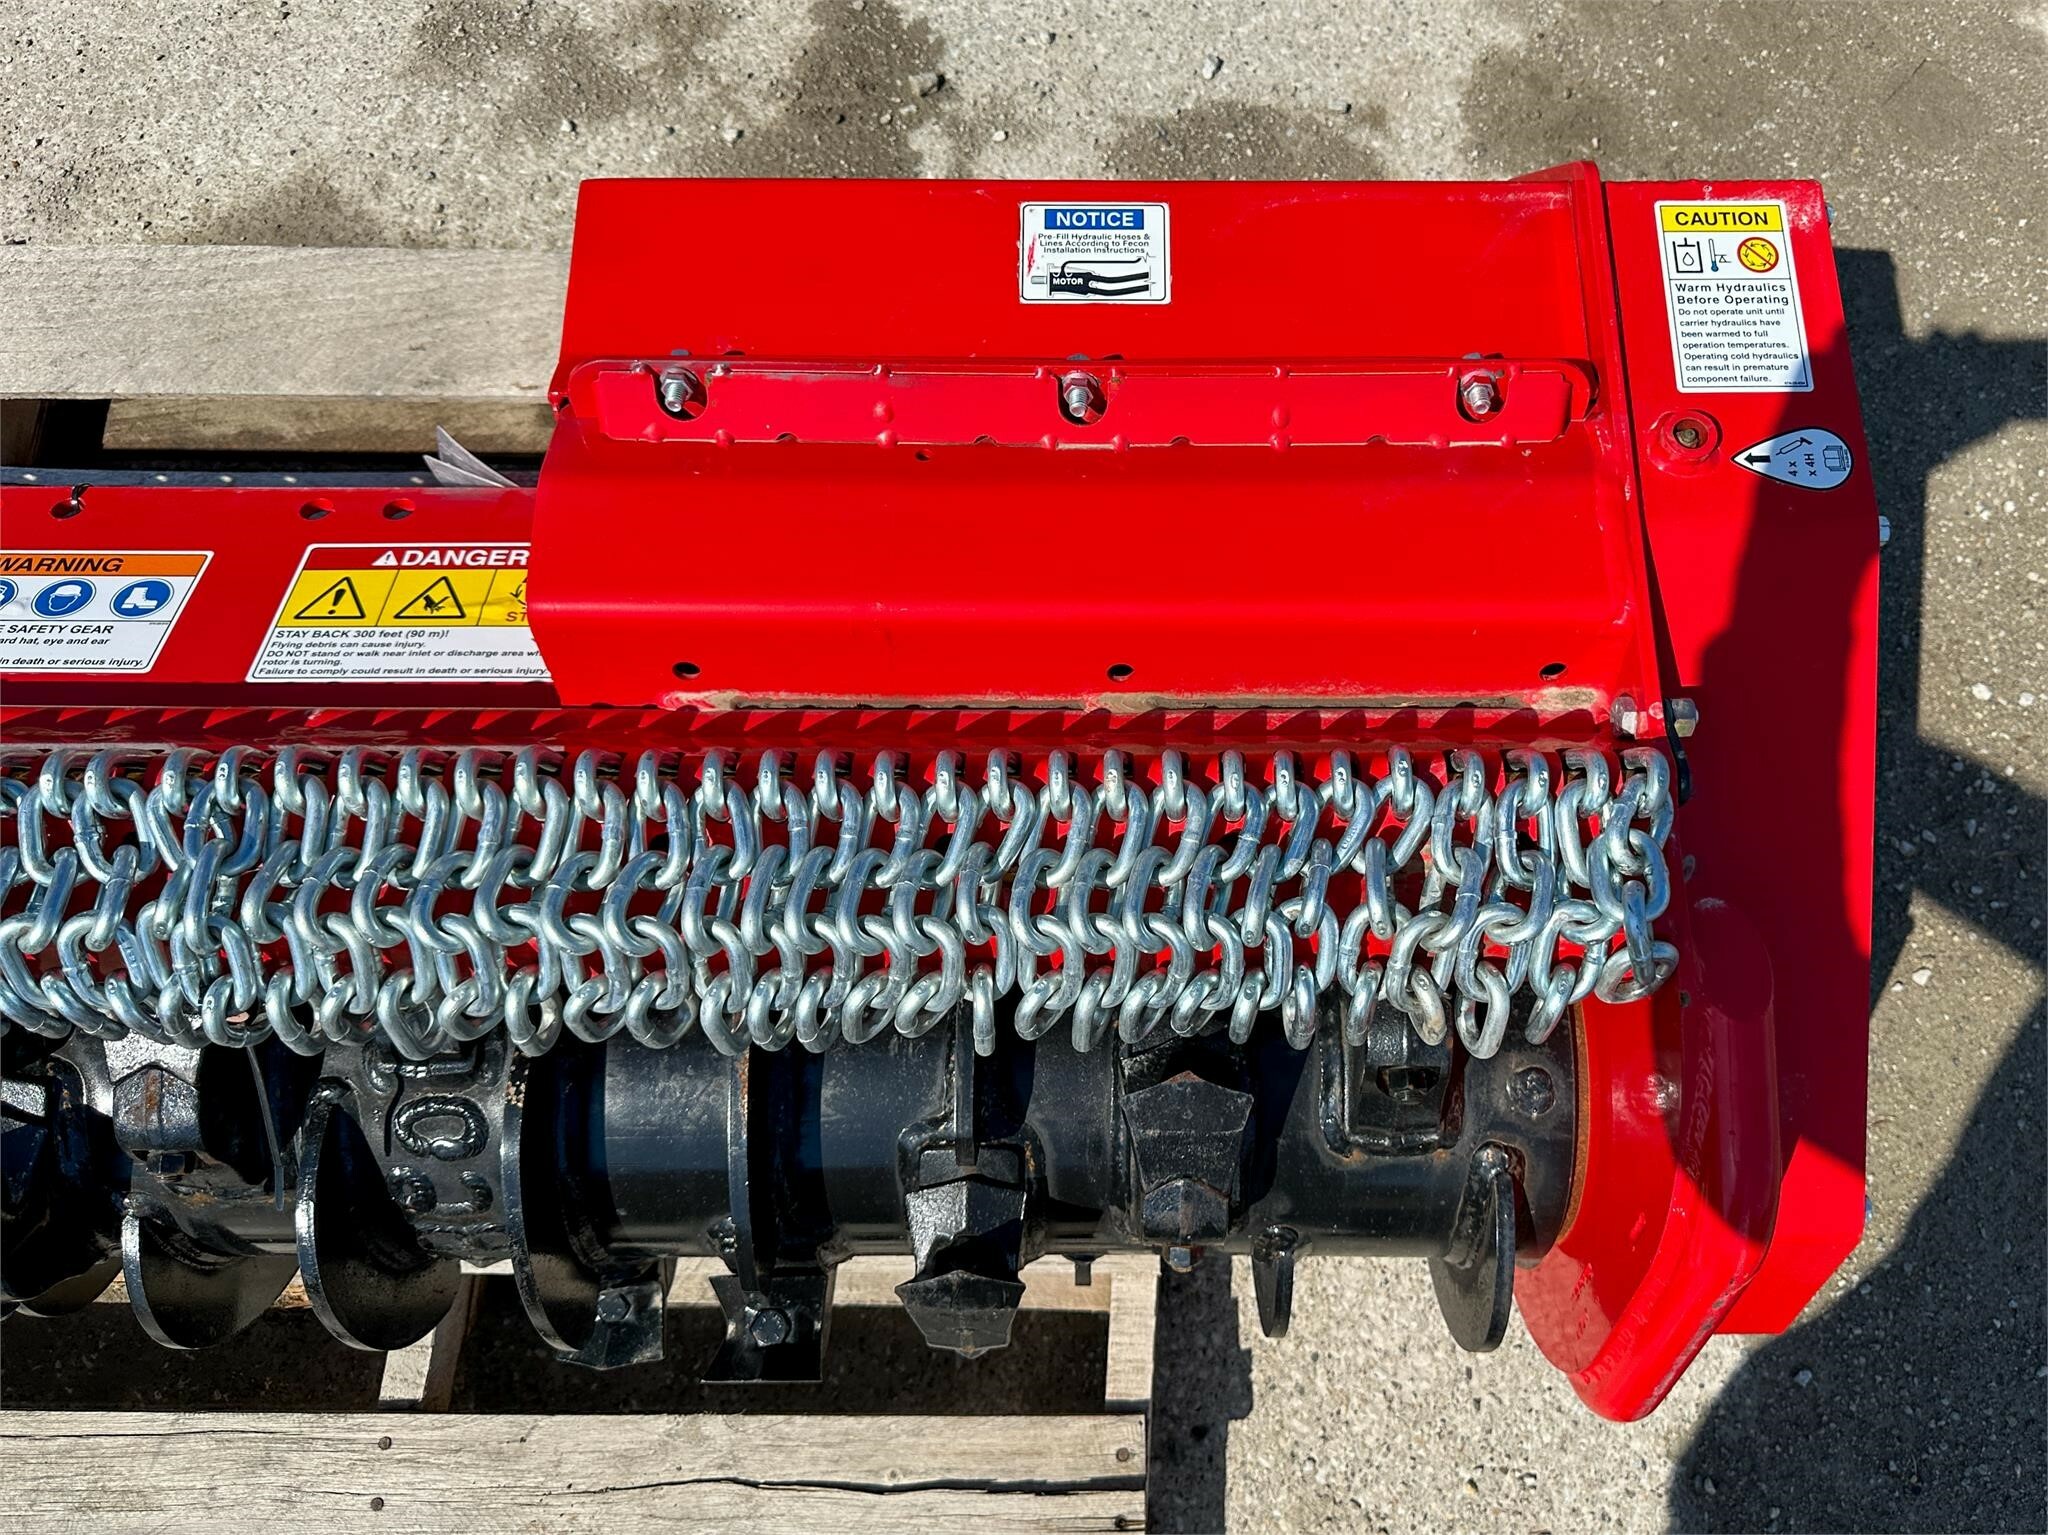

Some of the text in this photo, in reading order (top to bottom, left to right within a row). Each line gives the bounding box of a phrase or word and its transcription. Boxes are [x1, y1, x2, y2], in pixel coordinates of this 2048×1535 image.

[1056, 211, 1134, 227] NOTICE
[1674, 211, 1769, 226] CAUTION
[1071, 233, 1112, 242] Hydraulic
[1065, 240, 1109, 249] According
[1052, 277, 1083, 286] MOTOR
[1675, 283, 1786, 294] Warm Hydraulics
[1677, 295, 1789, 307] Before Operating
[1710, 309, 1743, 318] operate
[1680, 319, 1781, 329] carrier hydraulics have
[1681, 330, 1703, 338] been
[1705, 330, 1740, 338] warmed
[1682, 342, 1790, 351] operation temperatures.
[1684, 352, 1799, 362] Operating cold hydraulics
[1685, 364, 1702, 372] can
[1732, 363, 1741, 371] in
[1743, 364, 1789, 374] premature
[1687, 375, 1773, 385] component failure.
[401, 549, 531, 566] DANGER
[505, 611, 528, 623] ST
[7, 624, 68, 634] SAFETY
[70, 624, 114, 634] GEAR
[276, 630, 450, 639] STAY BACK 300 feet (90 m)!
[0, 636, 18, 645] ard
[19, 636, 40, 646] hat,
[43, 638, 64, 647] eye
[66, 637, 90, 645] and
[271, 641, 303, 650] Flying
[394, 641, 426, 649] injury.
[447, 650, 498, 658] discharge
[12, 656, 45, 665] death
[62, 657, 106, 665] serious
[108, 657, 143, 668] injury.
[302, 659, 343, 667] turning.
[310, 668, 347, 676] comply
[515, 667, 548, 676] injury.
